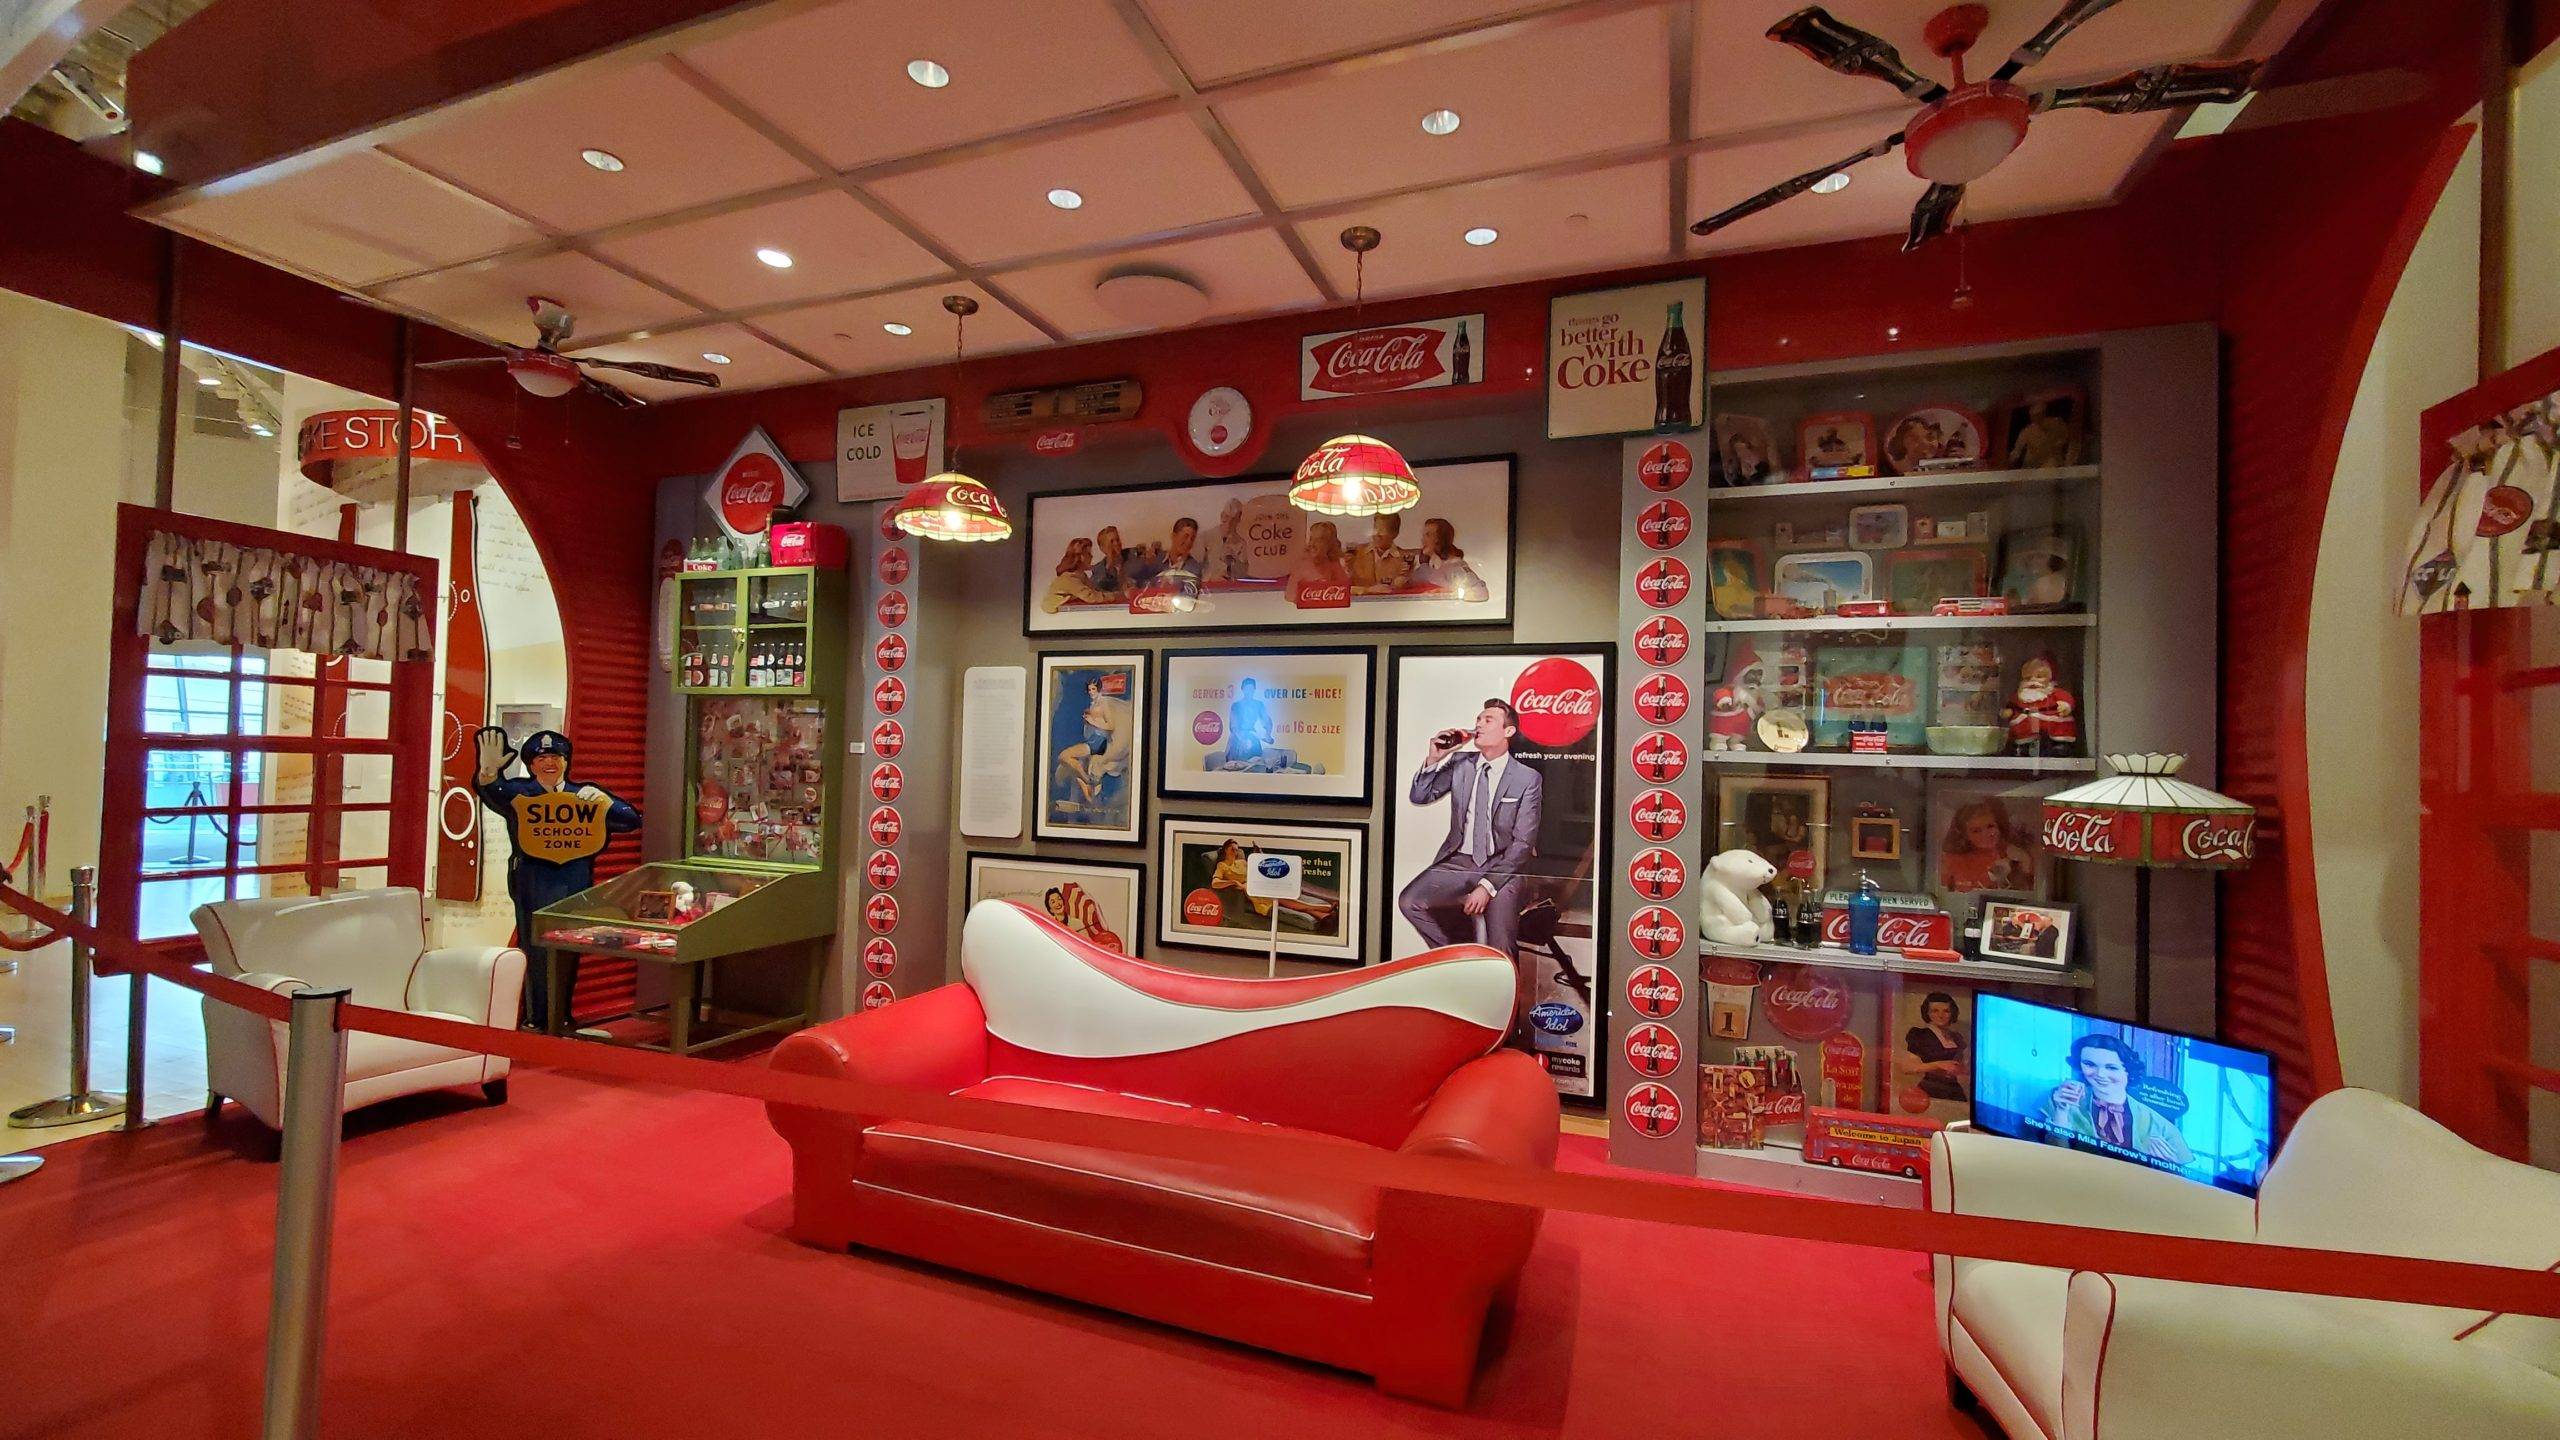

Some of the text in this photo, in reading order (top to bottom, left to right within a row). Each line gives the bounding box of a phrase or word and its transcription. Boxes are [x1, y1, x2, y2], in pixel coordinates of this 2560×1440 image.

[1602, 313, 1619, 327] go
[1561, 327, 1618, 346] better
[1586, 330, 1644, 360] with
[1558, 356, 1651, 390] Coke
[854, 423, 874, 438] ICE
[846, 445, 881, 461] COLD
[1249, 523, 1293, 541] Coke
[1254, 545, 1287, 557] CLUB
[1193, 688, 1225, 699] SERVES
[1227, 684, 1235, 699] 3
[1264, 688, 1288, 699] OVER
[1293, 720, 1305, 734] 16
[1321, 725, 1341, 734] SIZE
[1543, 754, 1562, 762] your
[1564, 753, 1595, 762] evening
[527, 803, 599, 824] SLOW
[533, 827, 592, 837] SCHOOL
[544, 840, 581, 849] ZONE
[1314, 858, 1332, 867] that
[1899, 897, 1929, 907] SERVED
[1529, 1006, 1577, 1017] American
[1544, 1018, 1569, 1032] Idol
[1721, 1012, 1734, 1032] 1
[1834, 1128, 1922, 1145] Welcome to Japan
[2024, 1116, 2051, 1131] She's
[2054, 1126, 2075, 1139] also
[2077, 1133, 2097, 1147] Mia
[2100, 1140, 2148, 1162] Farrow's
